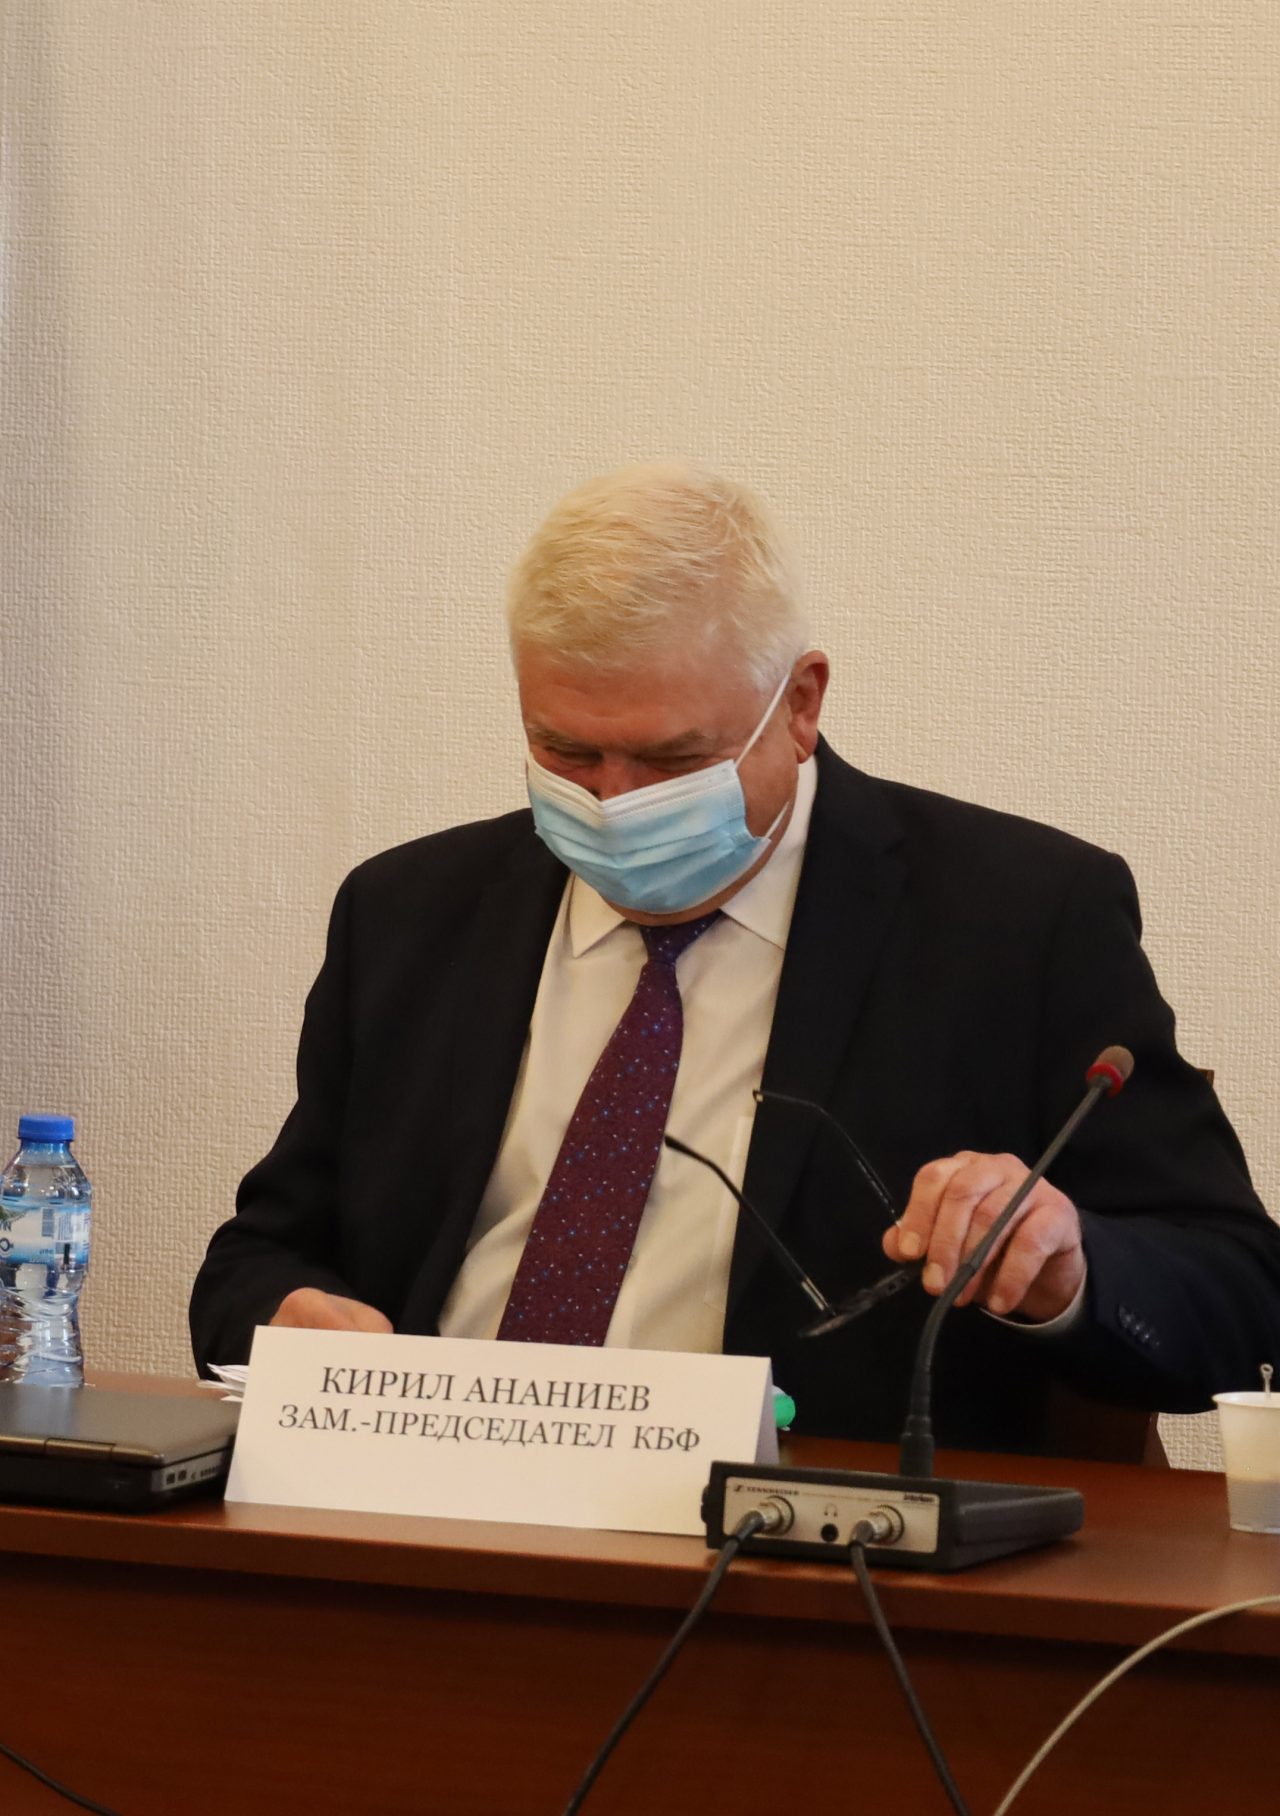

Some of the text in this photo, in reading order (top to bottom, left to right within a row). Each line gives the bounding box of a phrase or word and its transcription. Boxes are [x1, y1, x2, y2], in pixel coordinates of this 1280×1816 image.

[320, 1367, 650, 1411] КИРИЛ АНАНИЕВ
[278, 1404, 700, 1452] ЗАМ.-ПРЕДСЕДАТЕЛ КБФ
